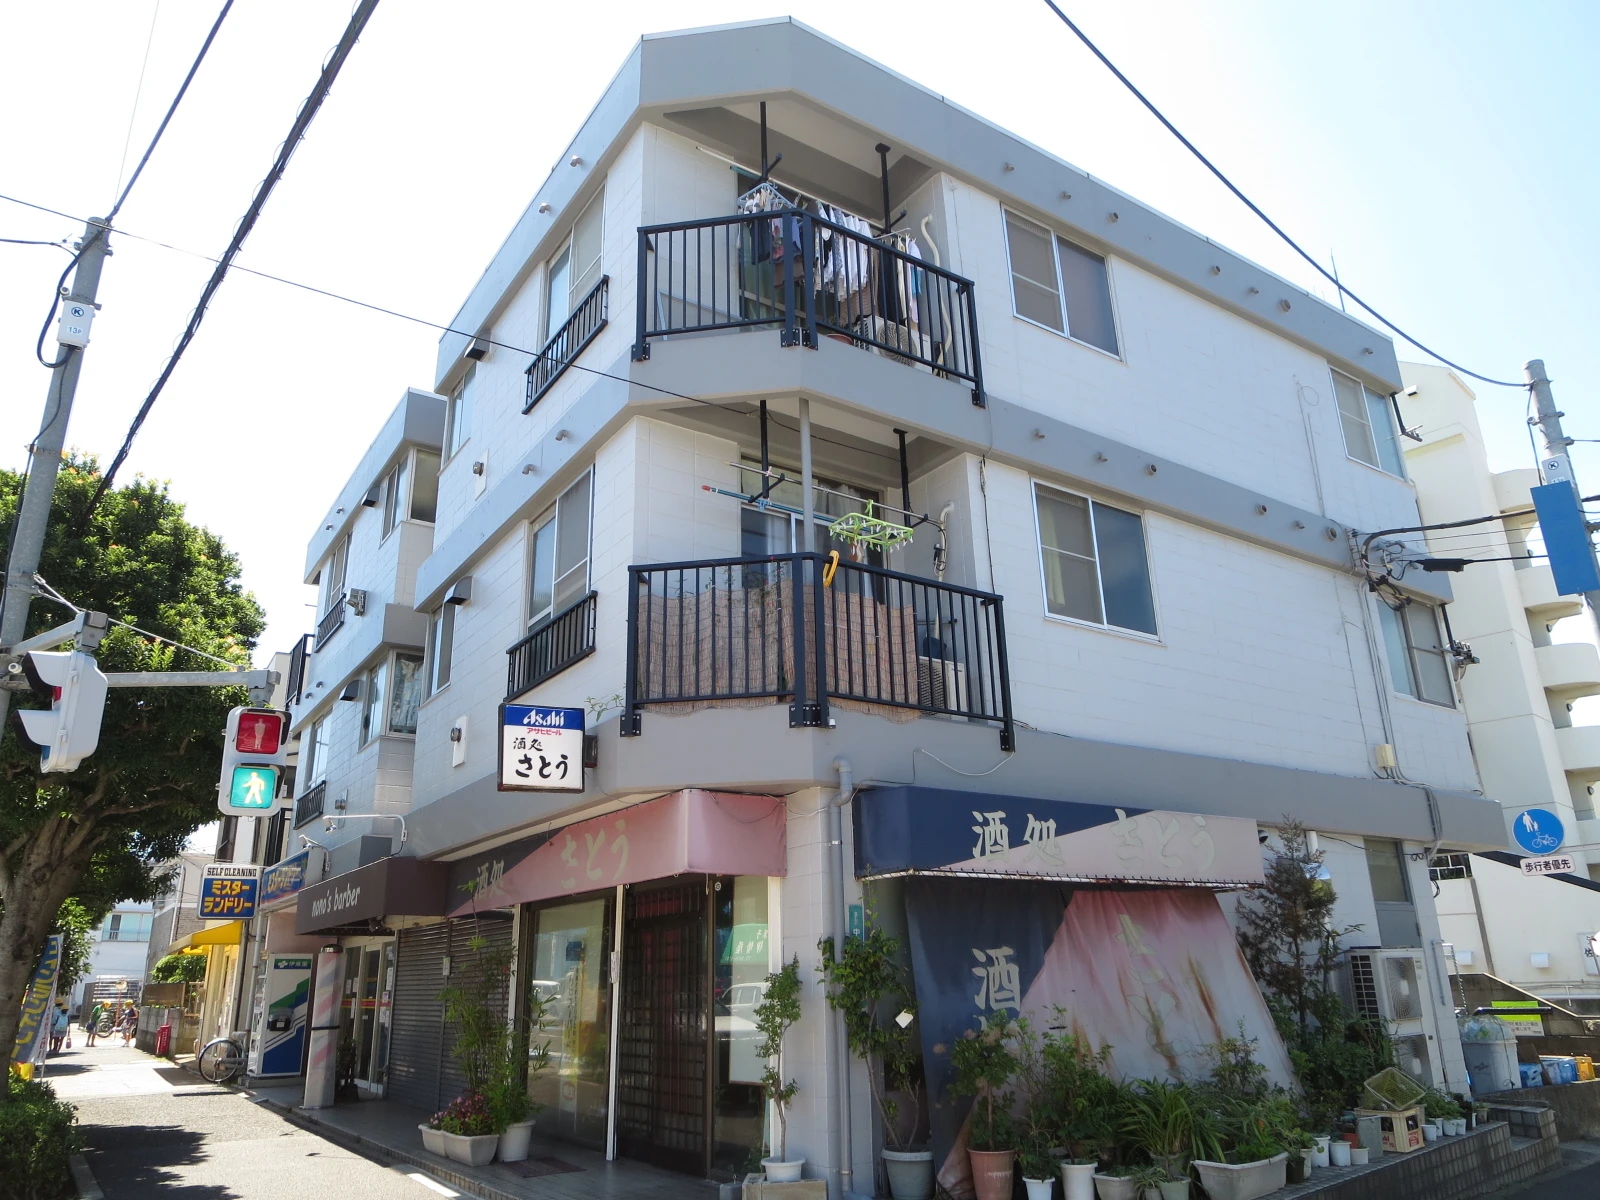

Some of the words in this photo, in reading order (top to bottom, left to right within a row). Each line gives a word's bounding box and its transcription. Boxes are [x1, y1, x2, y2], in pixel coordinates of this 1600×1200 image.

[523, 709, 565, 727] Asahi
[527, 727, 562, 736] アサヒビール
[513, 737, 543, 752] 酒処
[515, 753, 569, 781] さとう
[971, 810, 1065, 867] 酒処
[1110, 808, 1216, 873] さとう
[475, 859, 506, 900] 酒処
[560, 818, 630, 889] さとう
[1525, 858, 1571, 873] 歩行者優先
[207, 867, 224, 877] SELF
[224, 867, 257, 877] CLEANING
[211, 880, 250, 896] ミスター
[333, 882, 361, 911] barber
[203, 897, 252, 914] ランドリー
